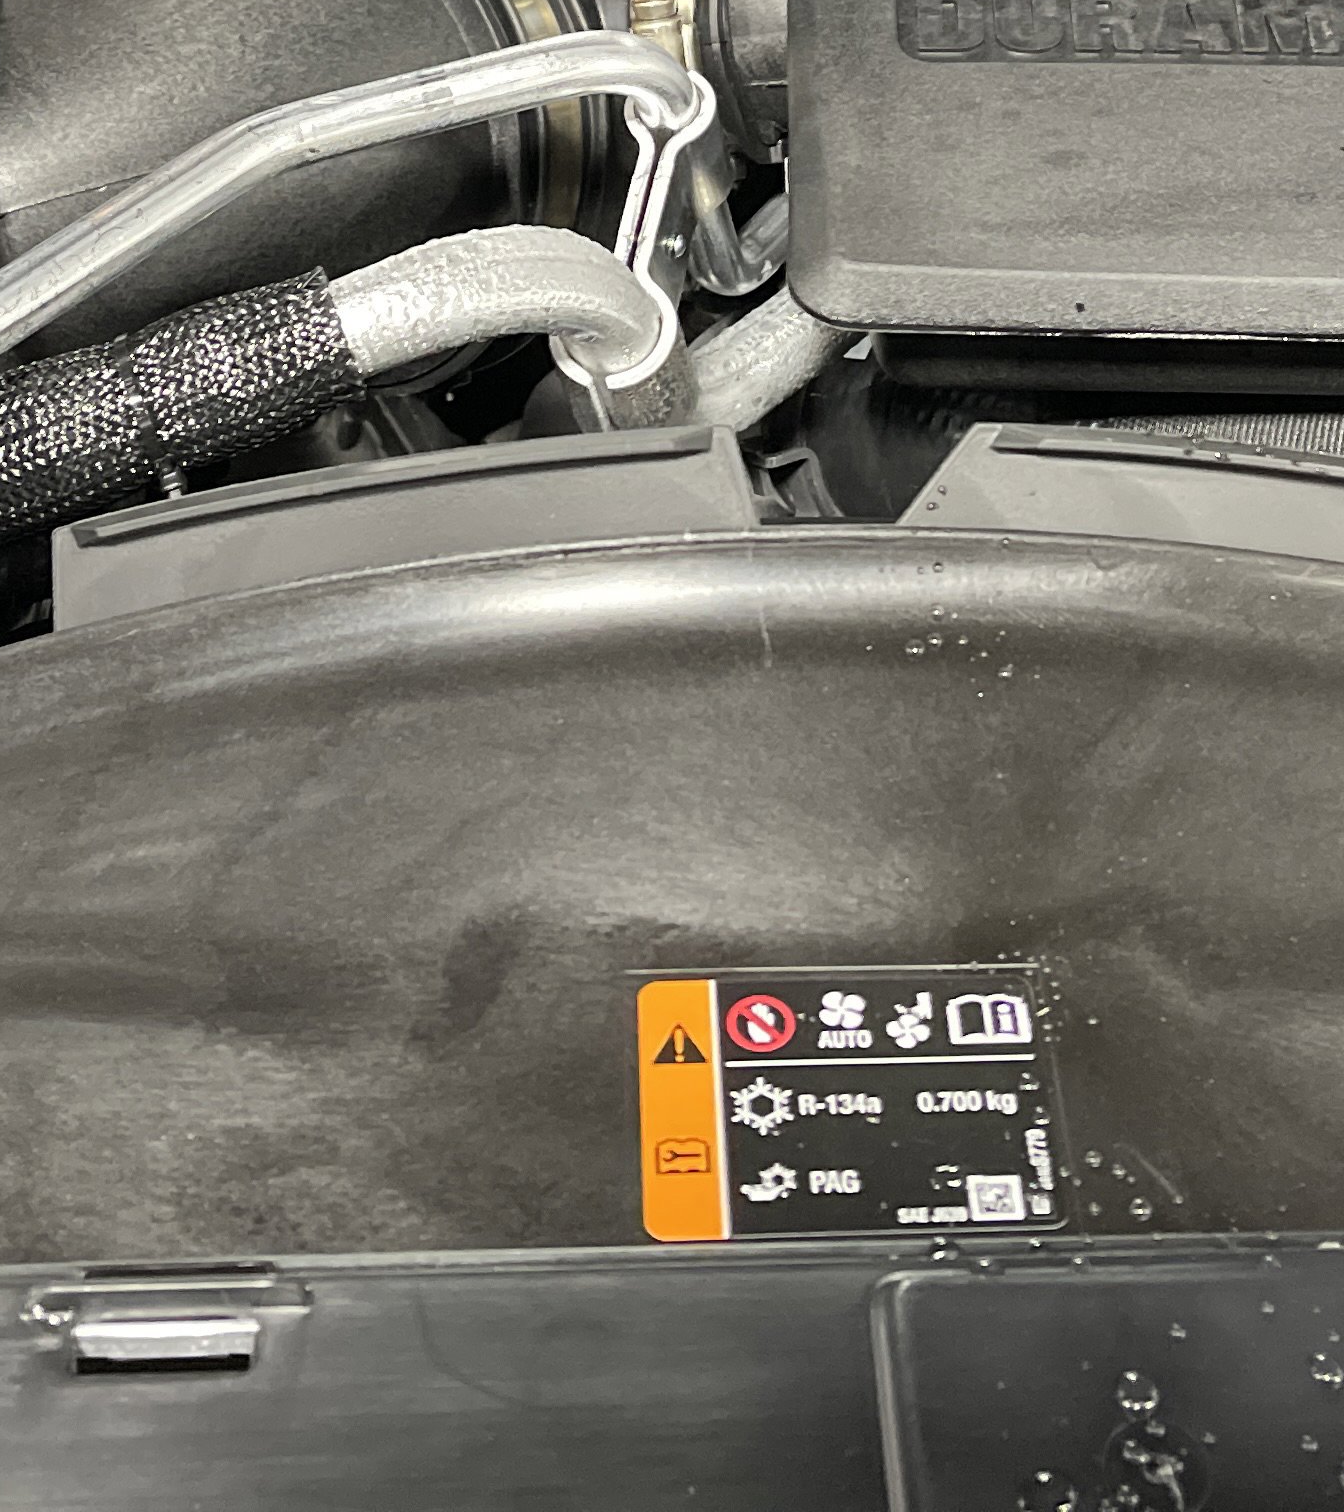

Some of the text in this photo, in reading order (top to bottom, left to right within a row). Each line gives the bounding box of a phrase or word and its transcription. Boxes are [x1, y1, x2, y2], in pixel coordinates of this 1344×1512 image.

[817, 1029, 873, 1050] AUTO
[798, 1090, 1020, 1117] R-134a 0.700 kg
[809, 1170, 862, 1195] PAG
